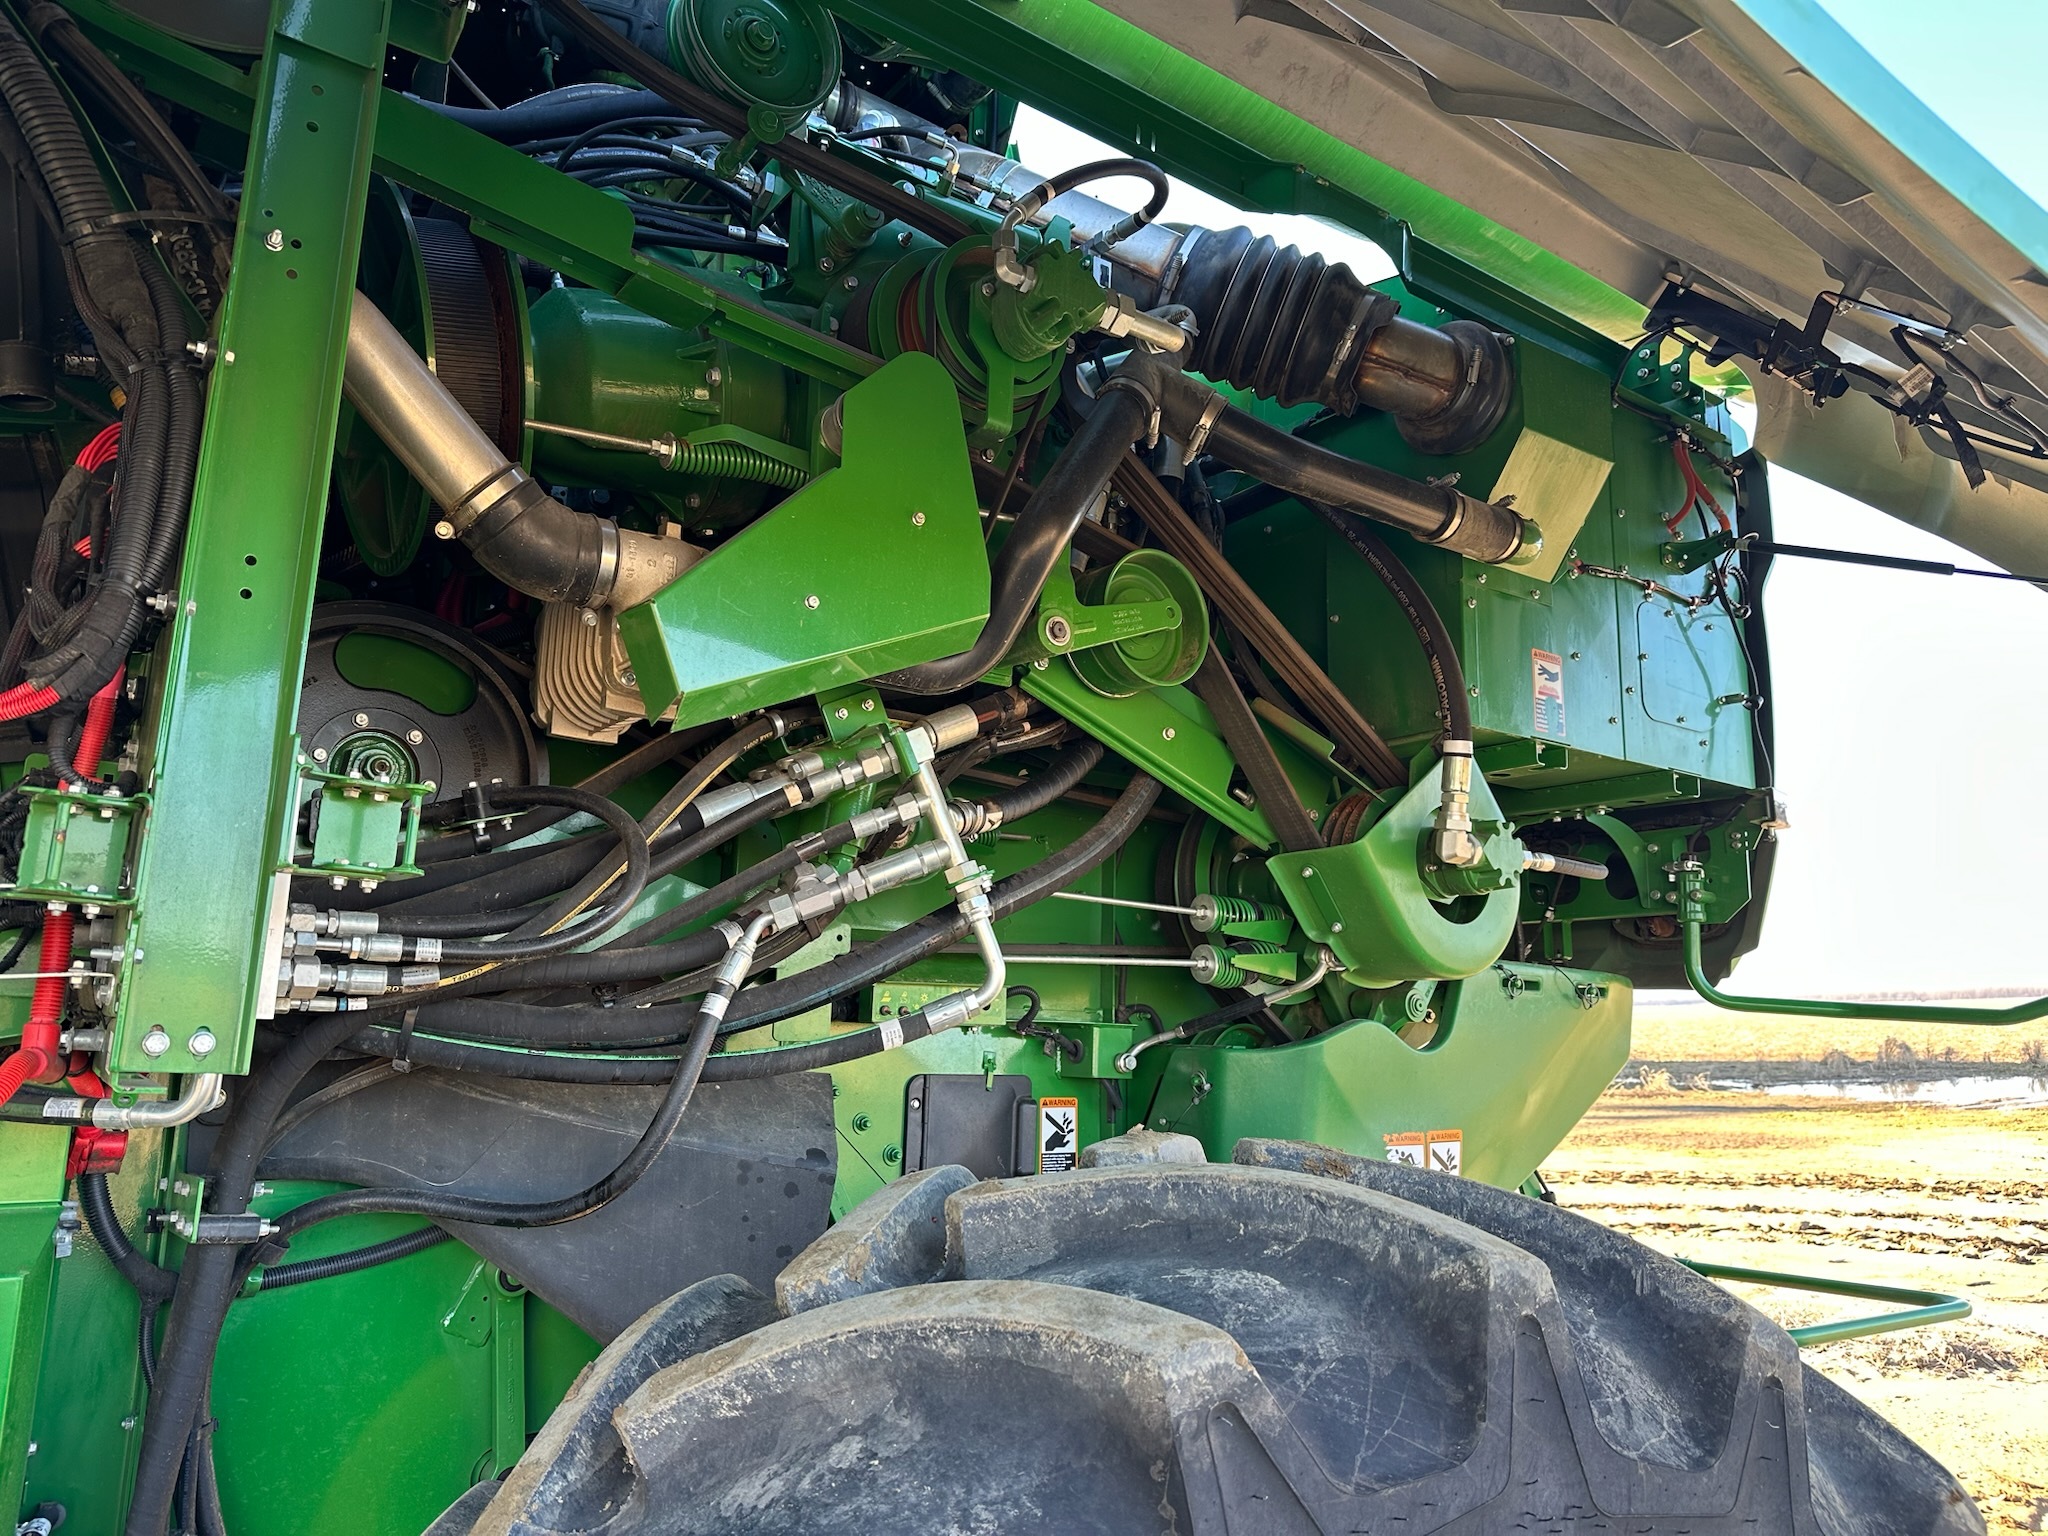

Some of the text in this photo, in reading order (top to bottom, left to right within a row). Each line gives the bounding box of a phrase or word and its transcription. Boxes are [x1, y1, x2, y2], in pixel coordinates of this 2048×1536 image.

[1537, 652, 1560, 664] WARNING
[1430, 654, 1453, 733] ALFAGOMMA
[1395, 1134, 1421, 1142] WARNING
[1436, 1132, 1460, 1140] WARNING
